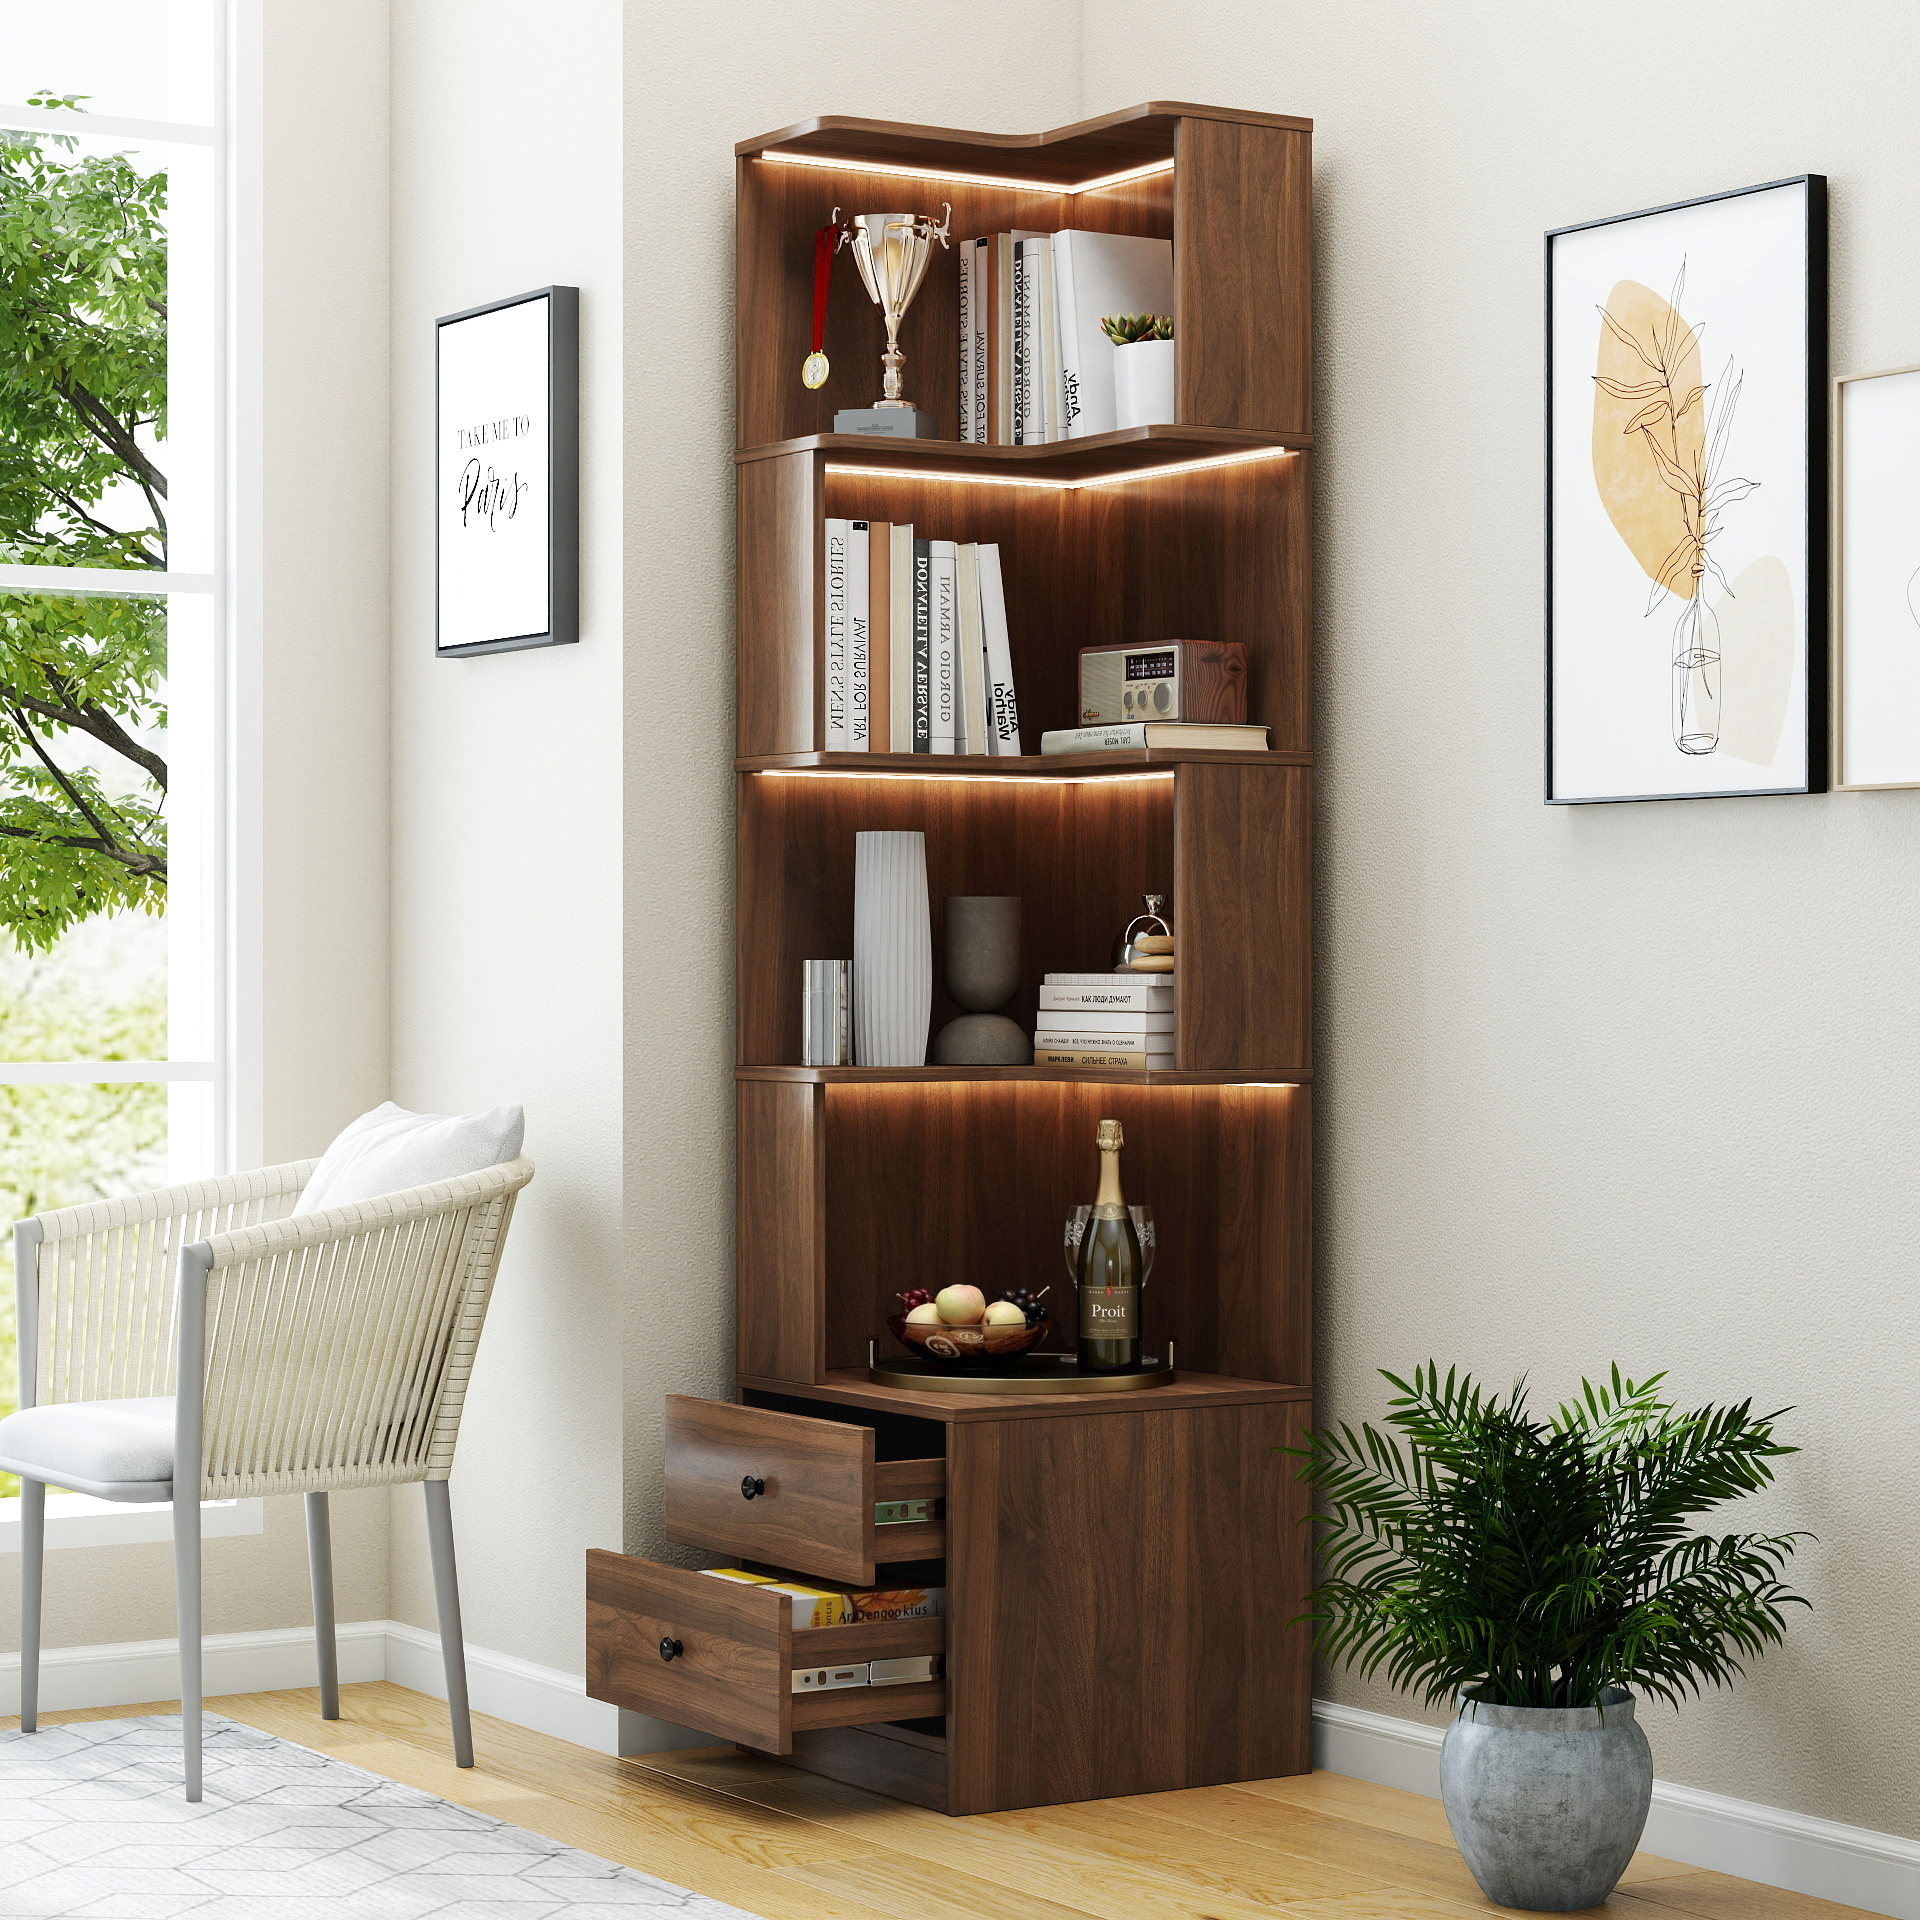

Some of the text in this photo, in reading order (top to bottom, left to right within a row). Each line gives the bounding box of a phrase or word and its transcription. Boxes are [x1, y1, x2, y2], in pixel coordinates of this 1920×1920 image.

[457, 414, 530, 449] TAKE ME TO
[458, 457, 529, 533] Paris
[1103, 736, 1131, 747] CARL MOSER
[1081, 995, 1092, 1003] КАК
[1092, 995, 1108, 1004] ЛЮДИ
[1108, 995, 1131, 1005] ДУМАЮТ
[1047, 1055, 1074, 1064] МАРК ЛЕВИ
[1081, 1056, 1128, 1066] СИЛЬНЕЕ СТРАХА
[1091, 1304, 1127, 1318] Proit
